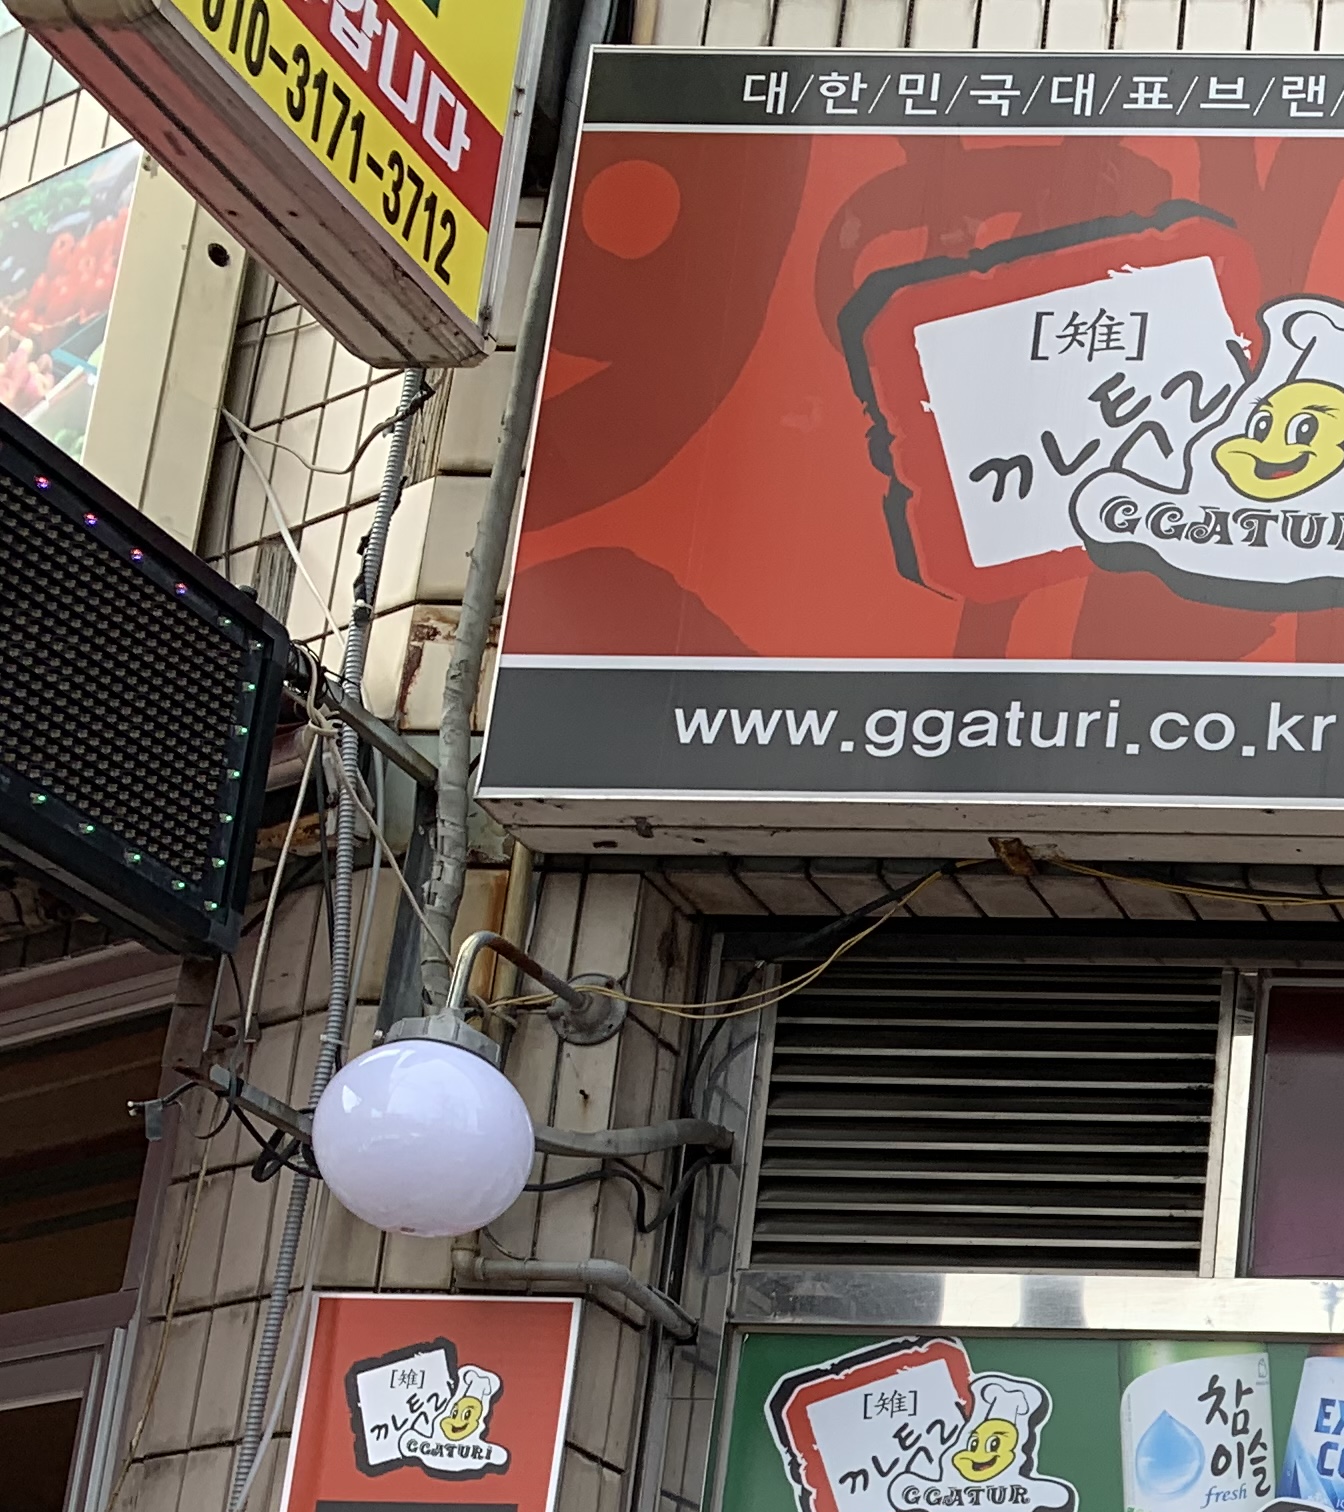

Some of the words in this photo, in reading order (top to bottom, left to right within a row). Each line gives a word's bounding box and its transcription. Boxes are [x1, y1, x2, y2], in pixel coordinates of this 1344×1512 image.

[673, 700, 1338, 759] www.ggaturi.co.kr
[406, 1438, 492, 1461] GGATURI
[1200, 1483, 1247, 1509] fresh
